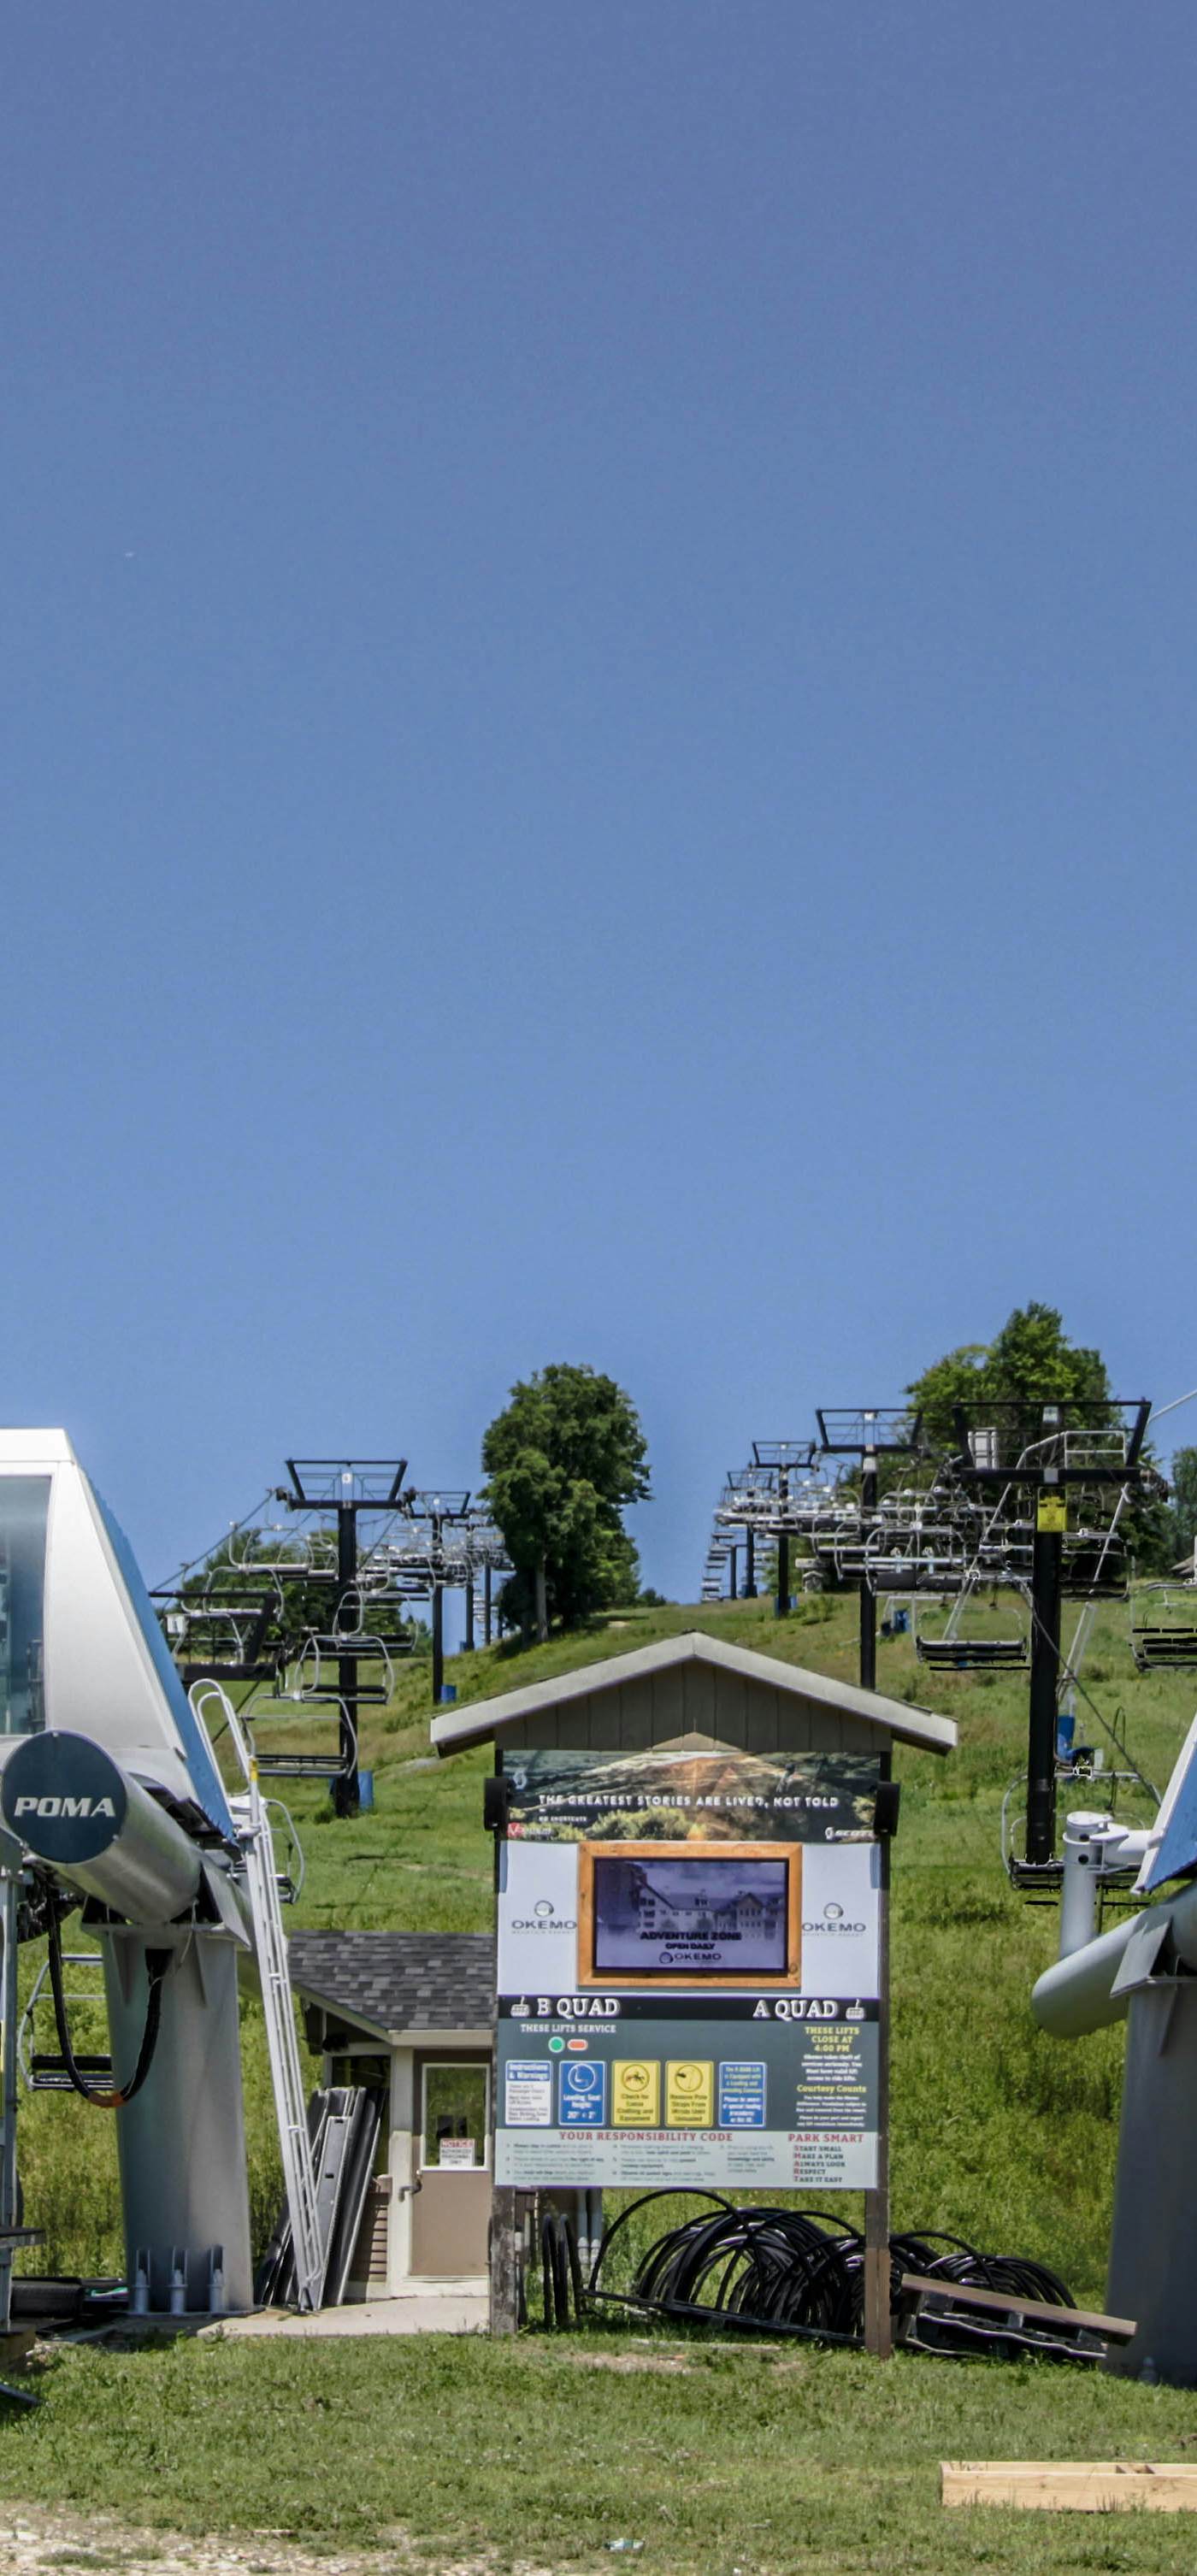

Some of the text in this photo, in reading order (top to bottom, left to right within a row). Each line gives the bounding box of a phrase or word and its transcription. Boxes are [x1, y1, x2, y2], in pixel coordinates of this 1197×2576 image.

[539, 1795, 840, 1808] THE GREATEST STORIES ARE LIVED, NOT TOLD
[14, 1797, 116, 1817] POMA
[511, 1920, 577, 1929] OKEMO
[801, 1923, 866, 1932] OKEMO
[640, 1931, 742, 1941] ADVENTURE ZONE
[537, 1998, 620, 2019] B QUAD
[752, 2000, 839, 2021] A QUAD
[520, 2024, 616, 2033] THESE LIFTS SERVICE
[805, 2026, 859, 2035] THESE LIFTS
[797, 2084, 867, 2094] Courtesy Counts
[559, 2132, 734, 2142] YOUR RESPONSIBILITY CODE
[787, 2133, 864, 2143] PARK SMART
